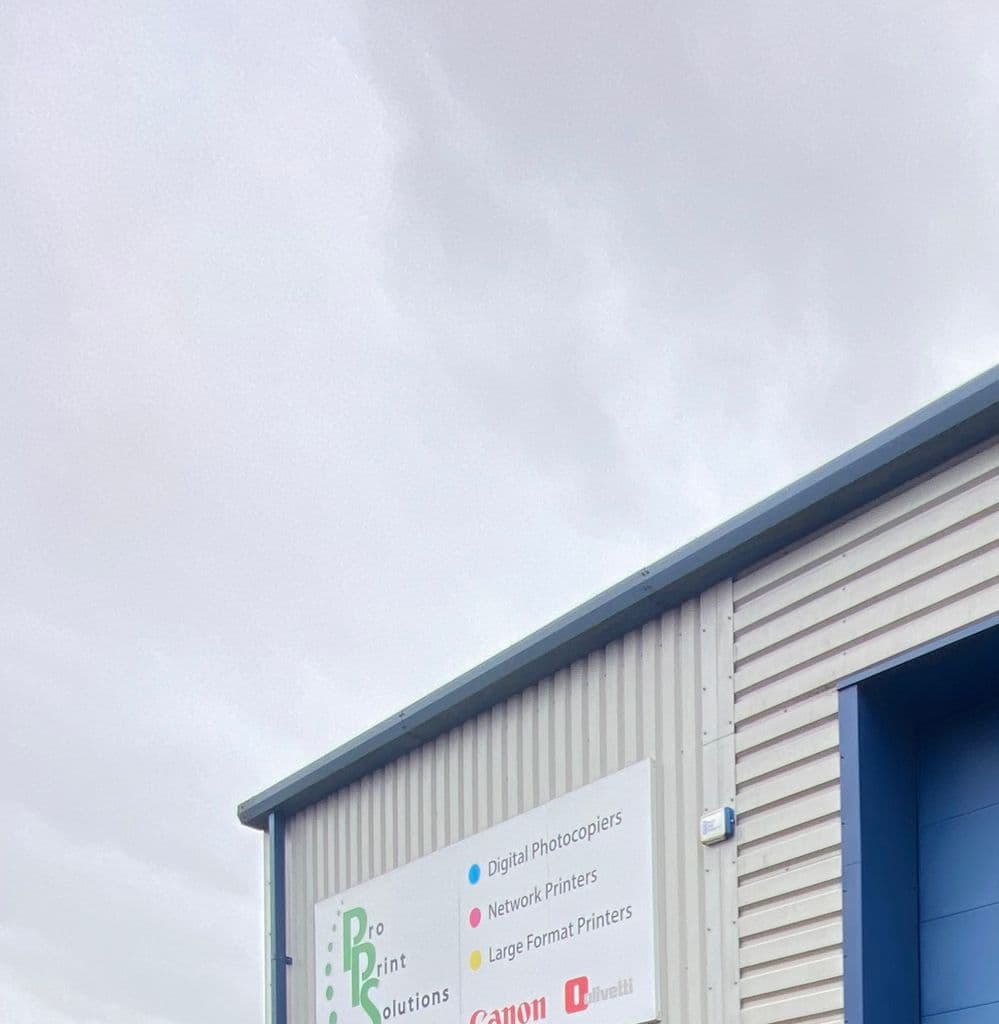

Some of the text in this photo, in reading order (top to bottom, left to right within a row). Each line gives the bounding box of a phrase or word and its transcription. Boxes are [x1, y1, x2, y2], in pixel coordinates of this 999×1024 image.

[488, 810, 622, 877] Digital Photocopiers
[488, 867, 598, 919] Network Printers
[342, 906, 384, 972] Pro
[488, 903, 633, 966] Large Format Printers
[351, 942, 407, 1007] Print
